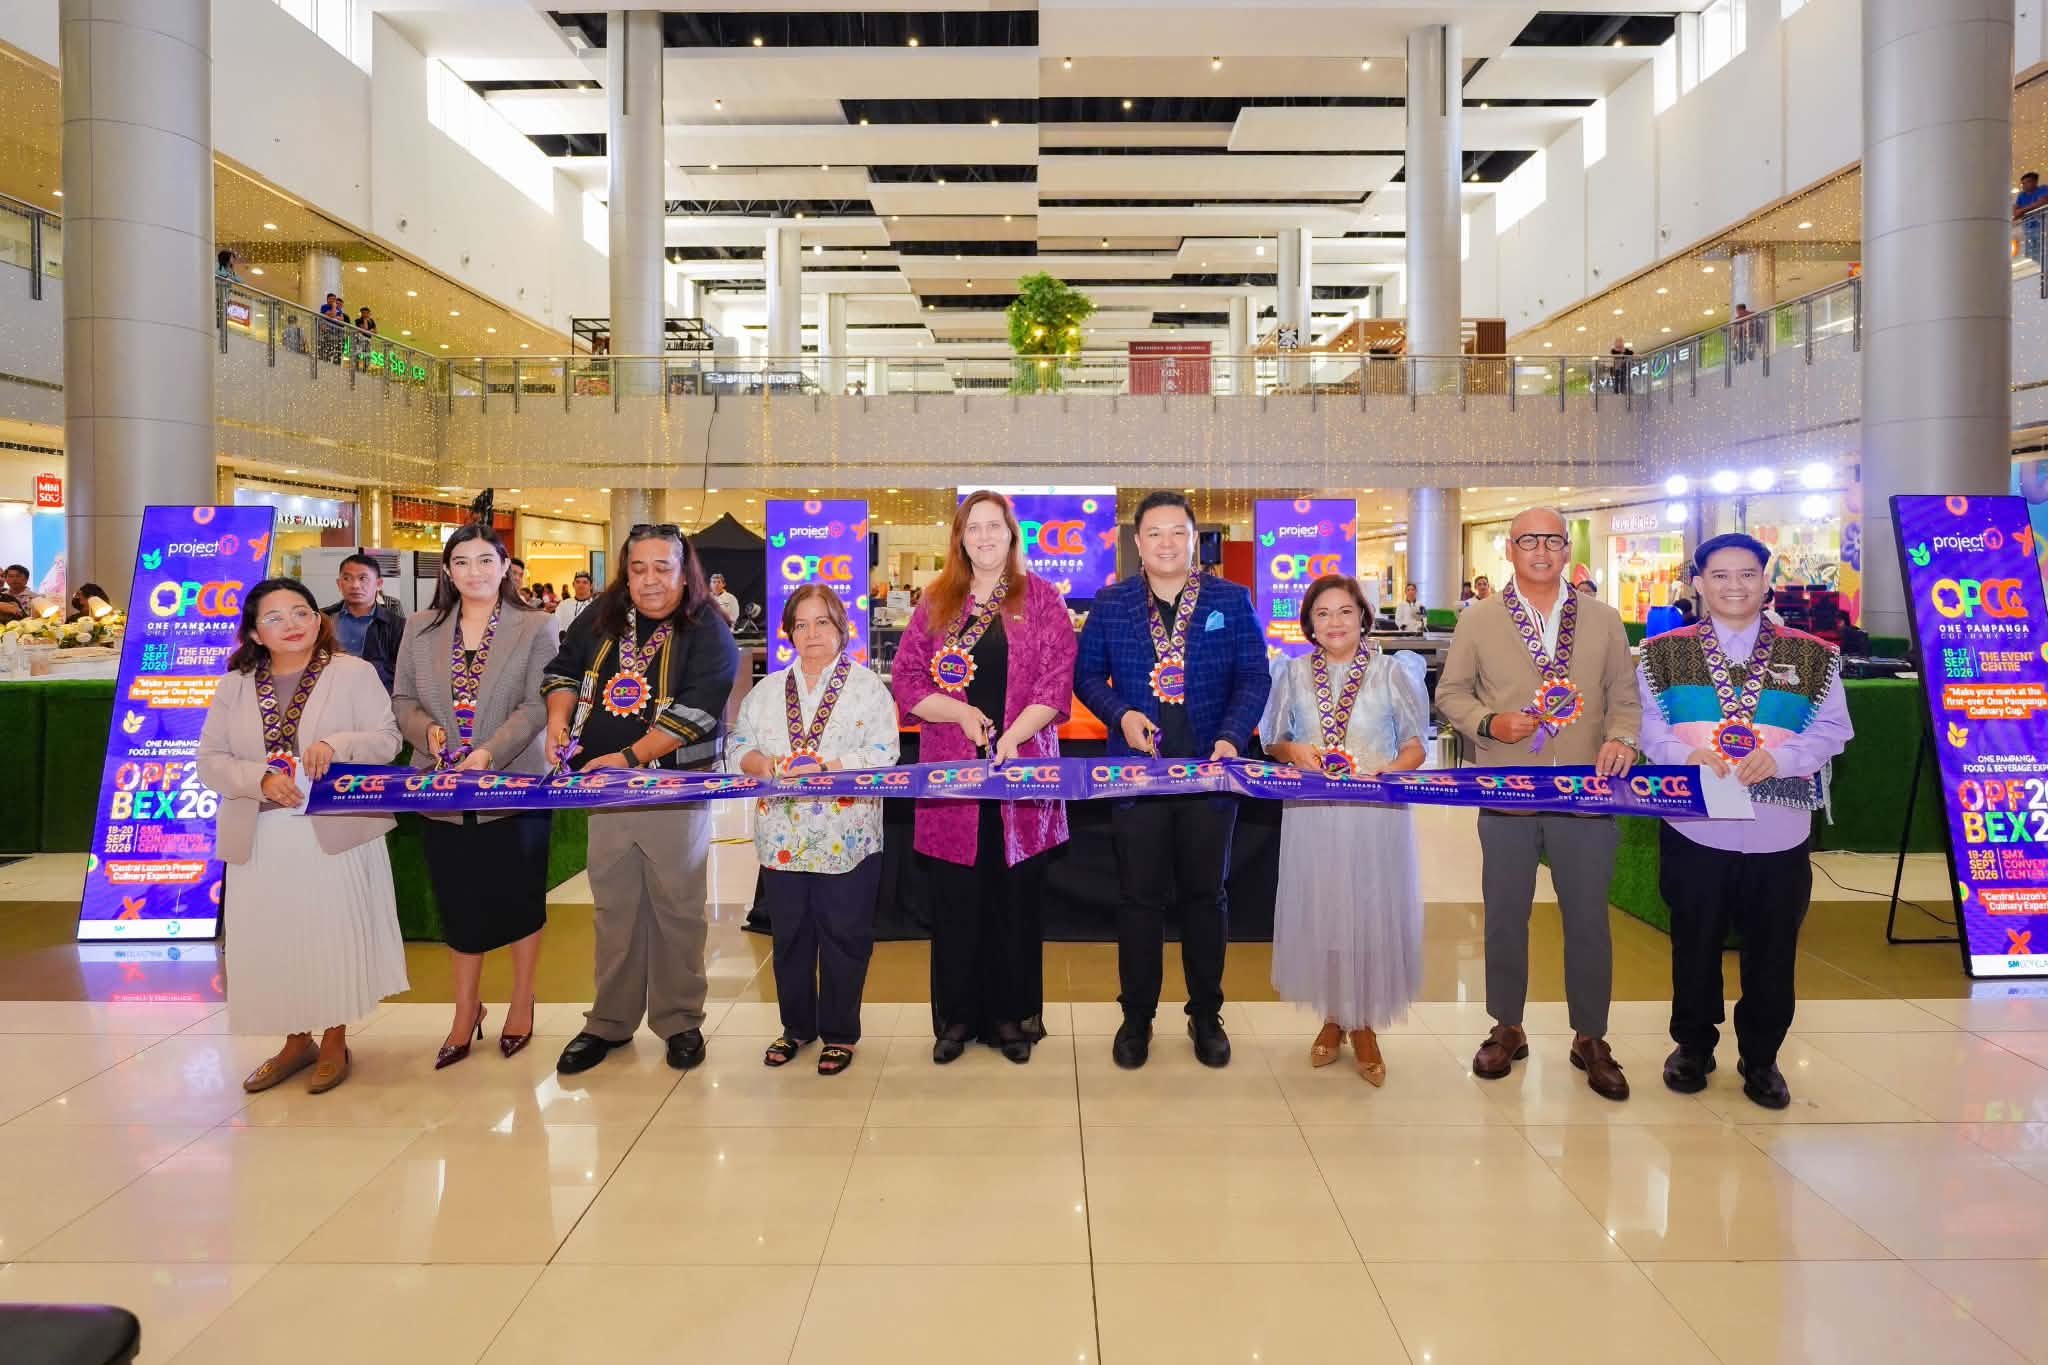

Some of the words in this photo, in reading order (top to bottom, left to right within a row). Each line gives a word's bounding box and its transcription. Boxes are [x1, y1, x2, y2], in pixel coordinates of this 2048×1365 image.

[789, 525, 829, 539] project
[1279, 524, 1318, 539] project
[1018, 519, 1087, 556] PCC
[1933, 532, 1984, 552] project
[168, 538, 219, 557] project
[1027, 559, 1084, 568] AMPANGA
[147, 622, 169, 630] ONE
[174, 622, 235, 631] PAMPANGA
[1939, 624, 1962, 633] ONE
[1967, 624, 2030, 633] PAMPANGA
[178, 647, 197, 656] THE
[199, 646, 233, 656] EVENT
[142, 652, 169, 661] SEPT
[176, 656, 216, 665] CENTRE
[1979, 652, 2000, 661] THE
[2000, 652, 2034, 661] EVENT
[1944, 657, 1970, 667] SEPT
[1981, 661, 2021, 672] CENTRE
[1946, 668, 1974, 678] 2026
[1986, 697, 2003, 706] One
[1969, 706, 2005, 717] Culinary
[145, 740, 162, 748] ONE
[163, 740, 201, 748] PAMPANG
[128, 748, 150, 756] FOOD
[1977, 754, 1995, 763] ONE
[1996, 754, 2037, 763] PAMPANGA
[1963, 764, 1985, 773] FOOD
[116, 761, 208, 791] OPF2
[110, 790, 218, 820] BEX26
[106, 834, 133, 844] SEPT
[2001, 849, 2024, 859] SMX
[1969, 859, 1996, 869] SEPT
[1971, 869, 1998, 880] 2026
[1989, 901, 2023, 912] Culinary
